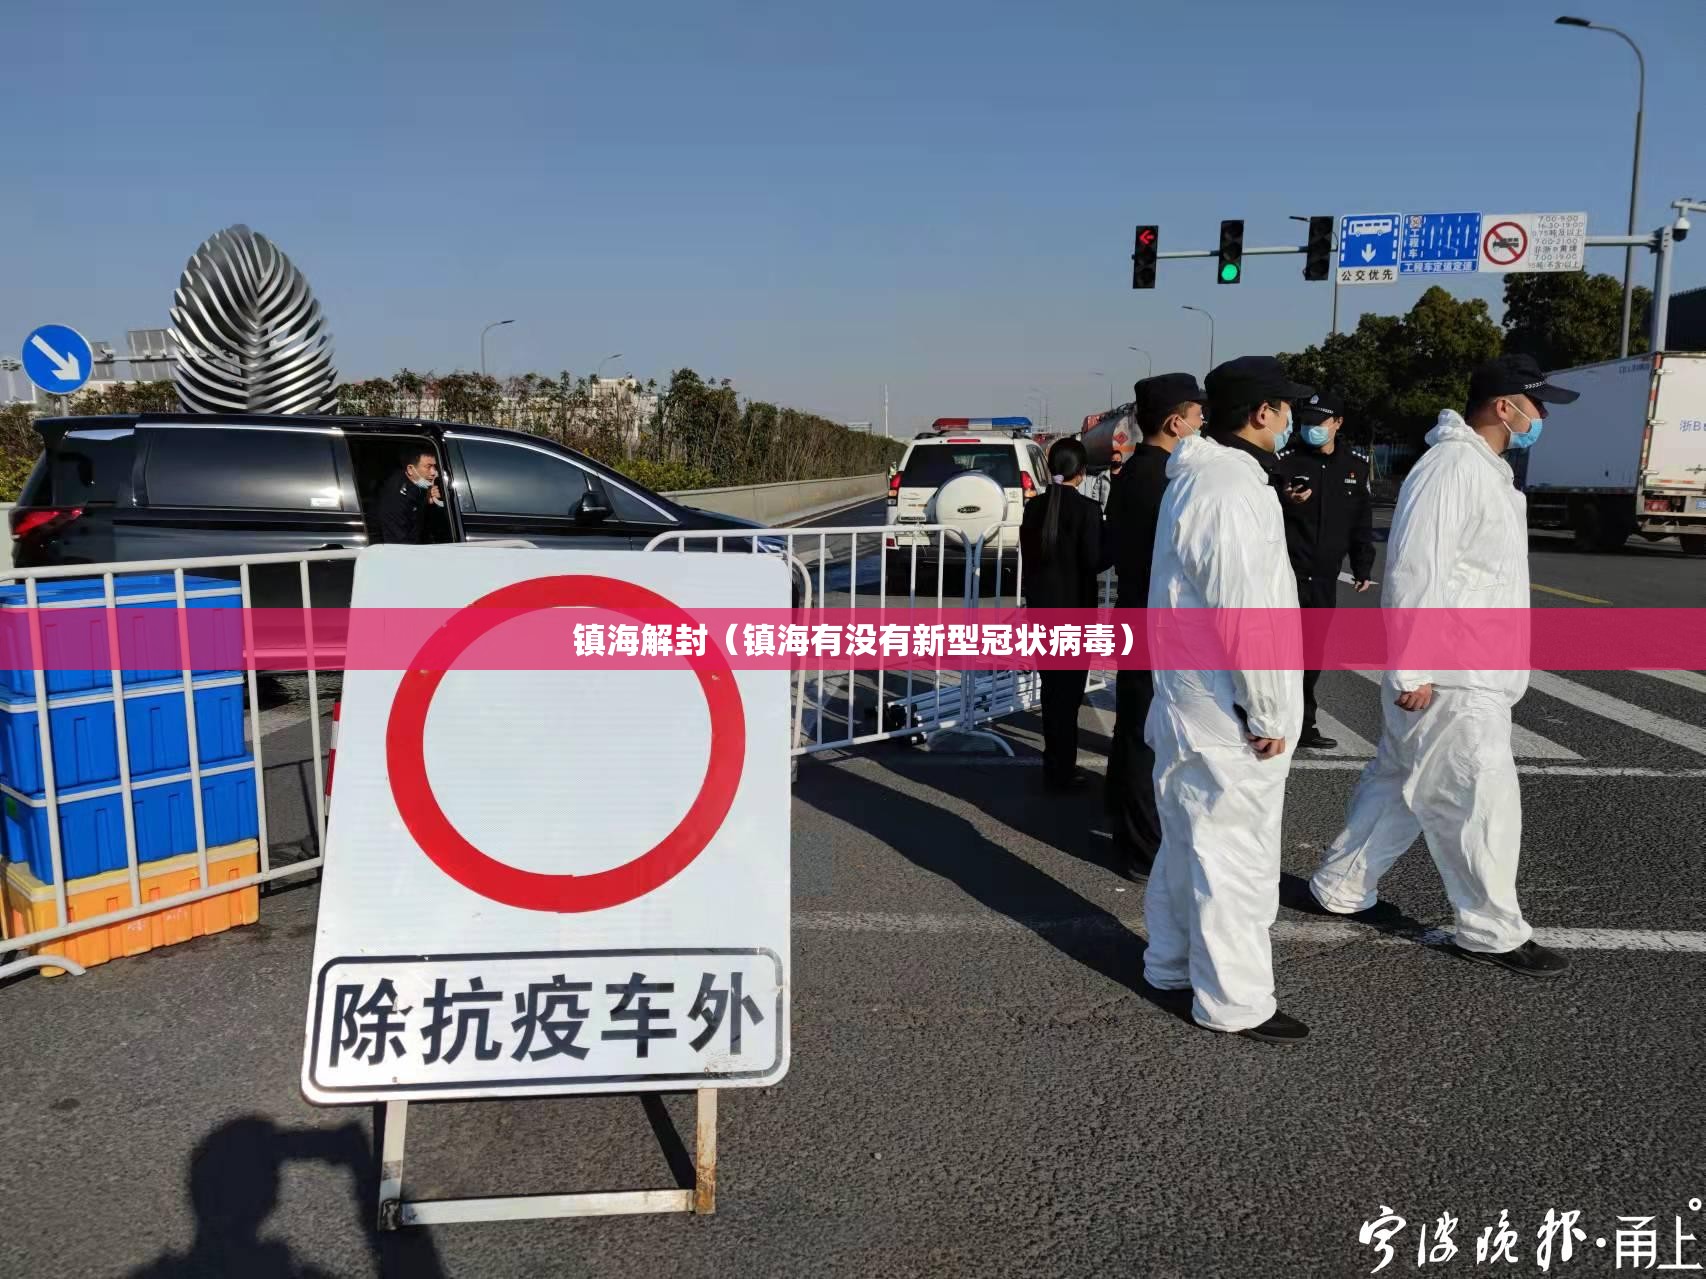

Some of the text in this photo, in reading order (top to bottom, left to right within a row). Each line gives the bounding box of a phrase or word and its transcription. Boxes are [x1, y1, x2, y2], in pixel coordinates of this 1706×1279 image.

[1341, 269, 1393, 282] 公交优先
[329, 971, 764, 1068] 除抗疫车外
